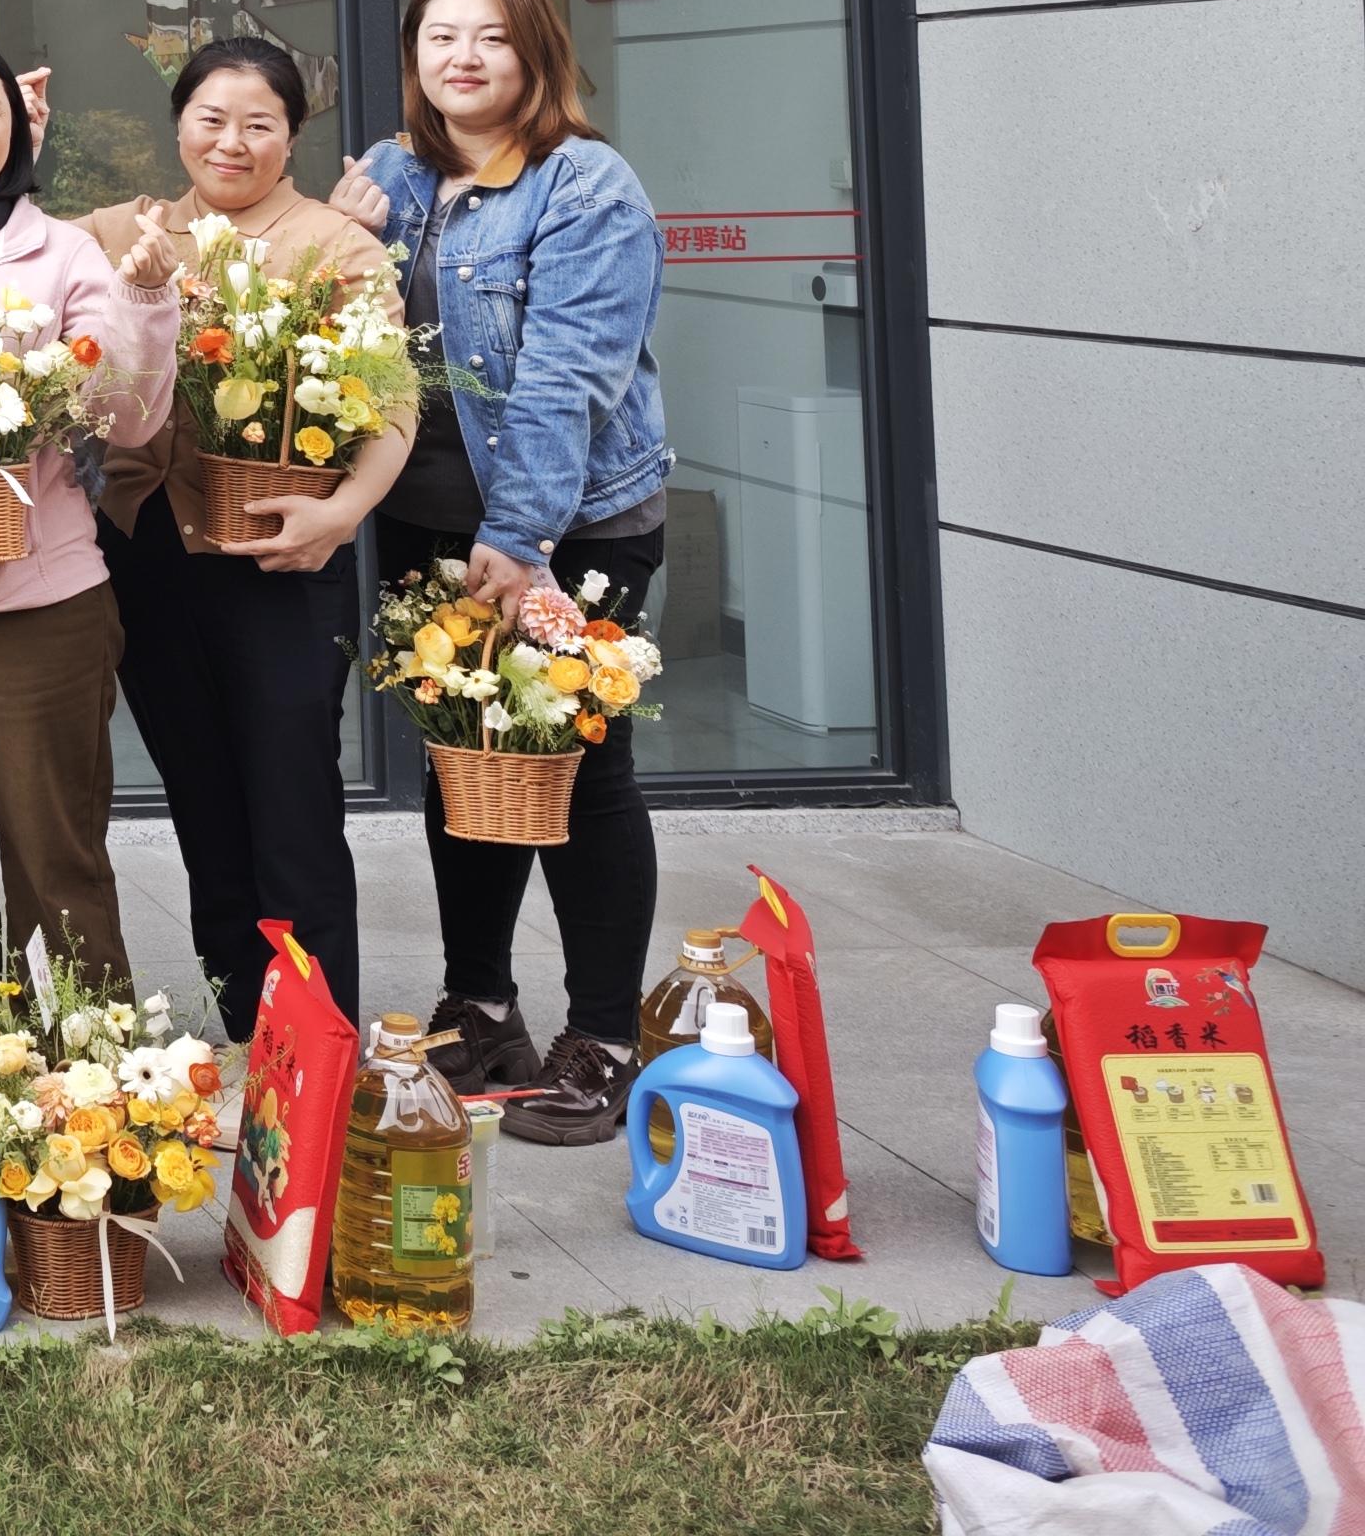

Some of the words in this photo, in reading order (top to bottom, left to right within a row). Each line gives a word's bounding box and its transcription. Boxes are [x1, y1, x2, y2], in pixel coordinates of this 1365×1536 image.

[666, 224, 747, 253] 好驿站
[1124, 1020, 1228, 1050] 稻香米
